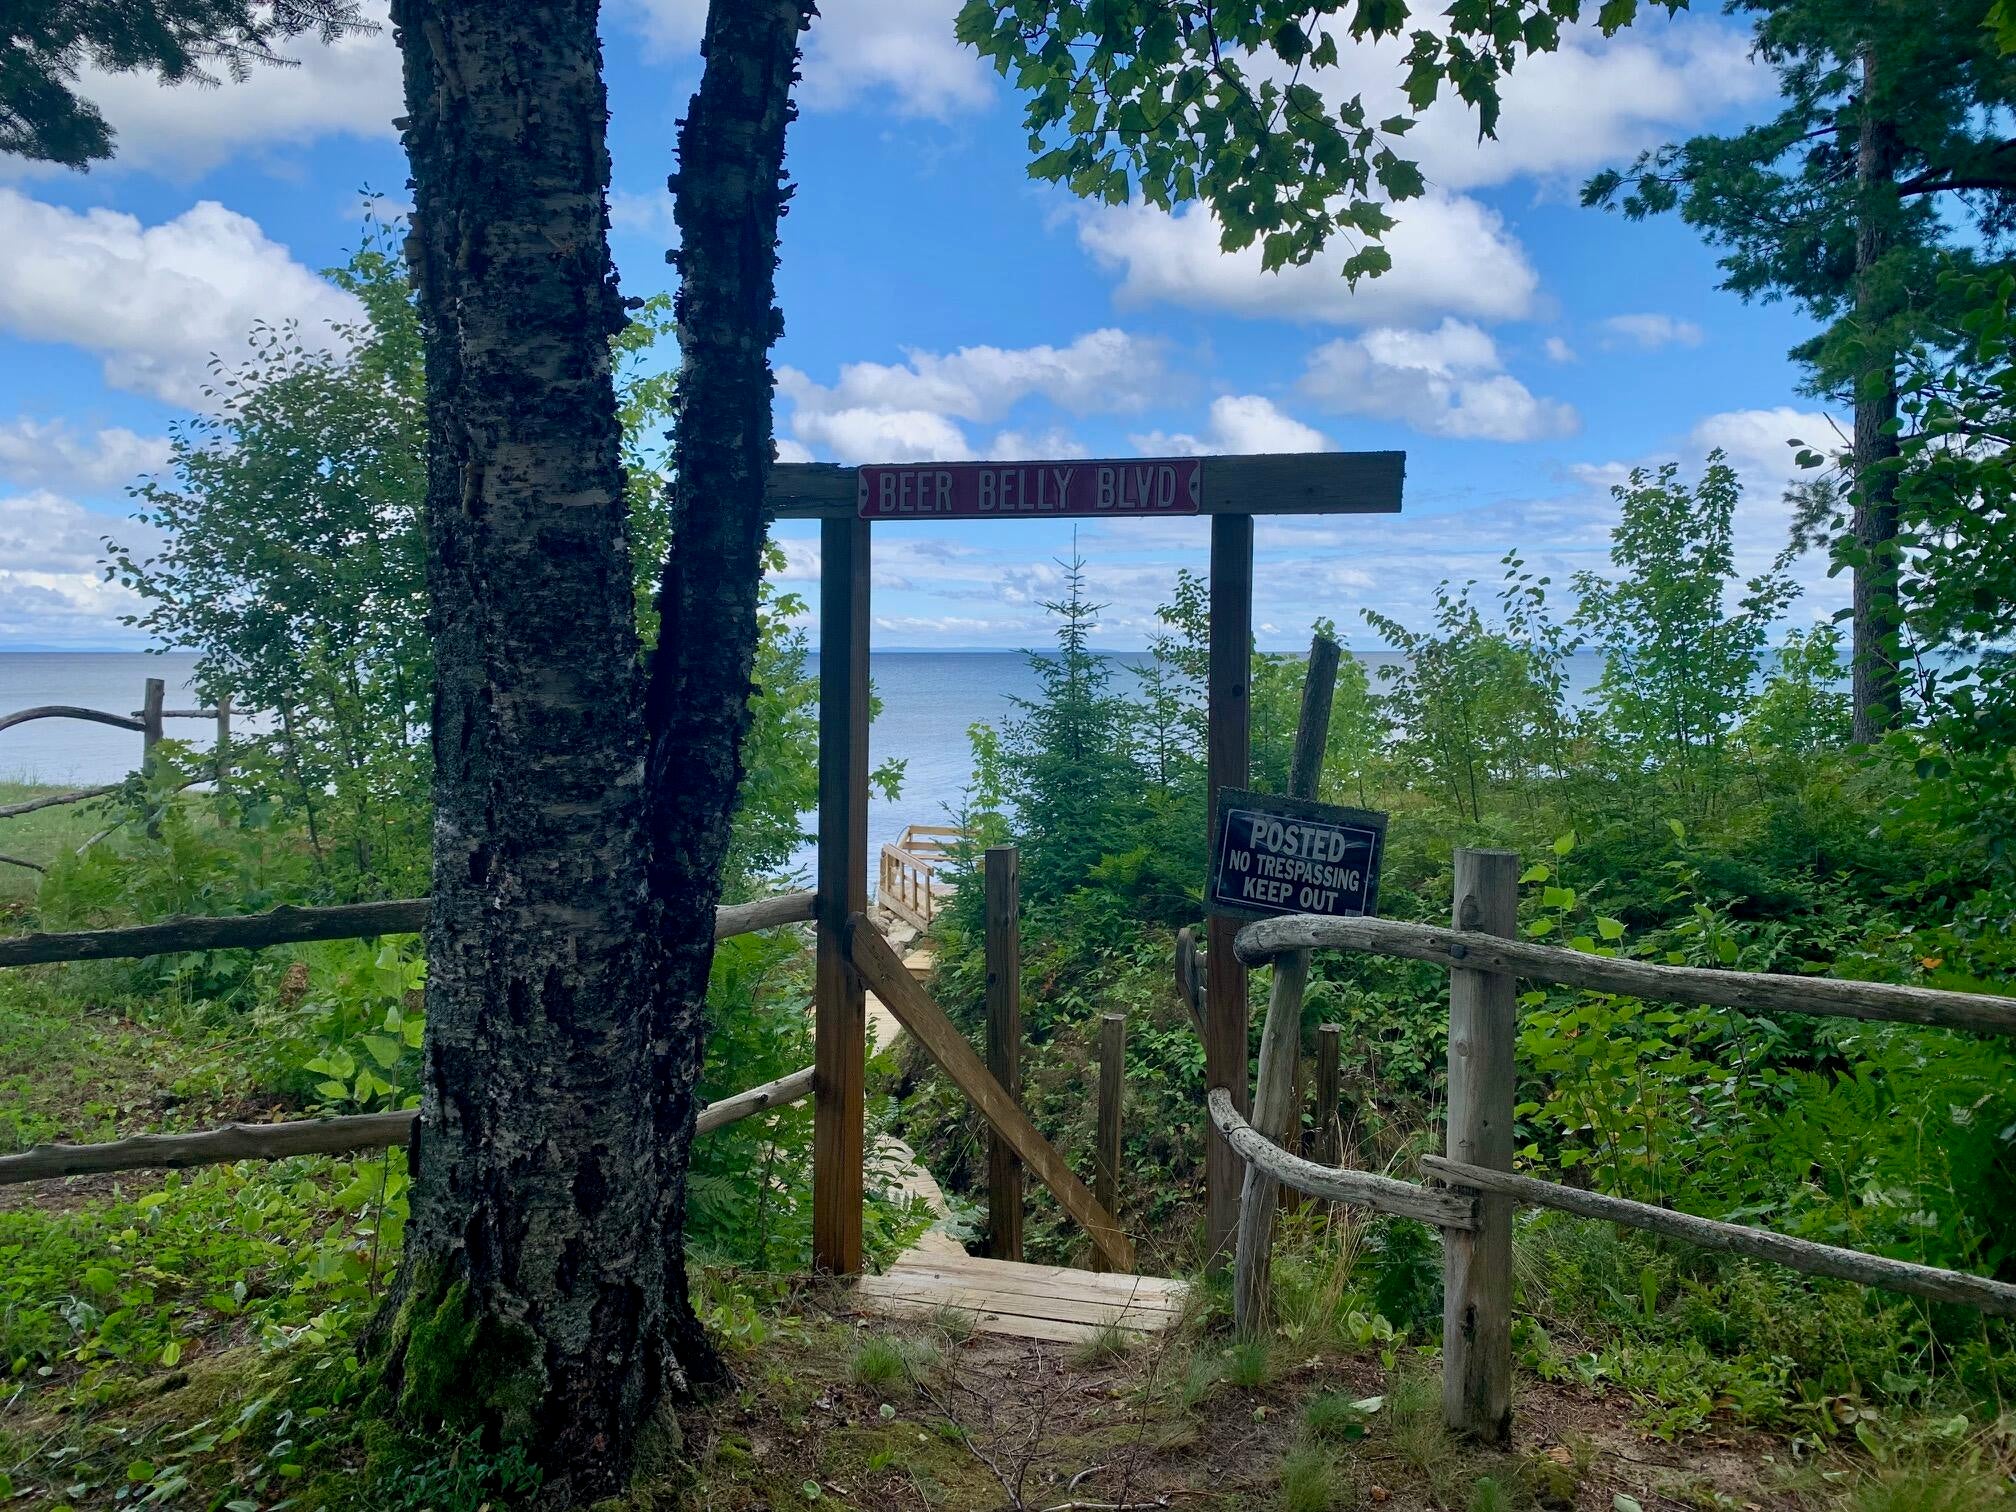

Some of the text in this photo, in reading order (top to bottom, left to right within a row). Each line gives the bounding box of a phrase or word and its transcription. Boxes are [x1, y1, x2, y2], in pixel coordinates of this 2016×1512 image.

[879, 464, 1177, 512] BEER BELLY BLVD
[1250, 820, 1345, 862] POSTED
[1229, 850, 1359, 891] NO TRESPASSING
[1243, 877, 1338, 912] KEEP OUT
